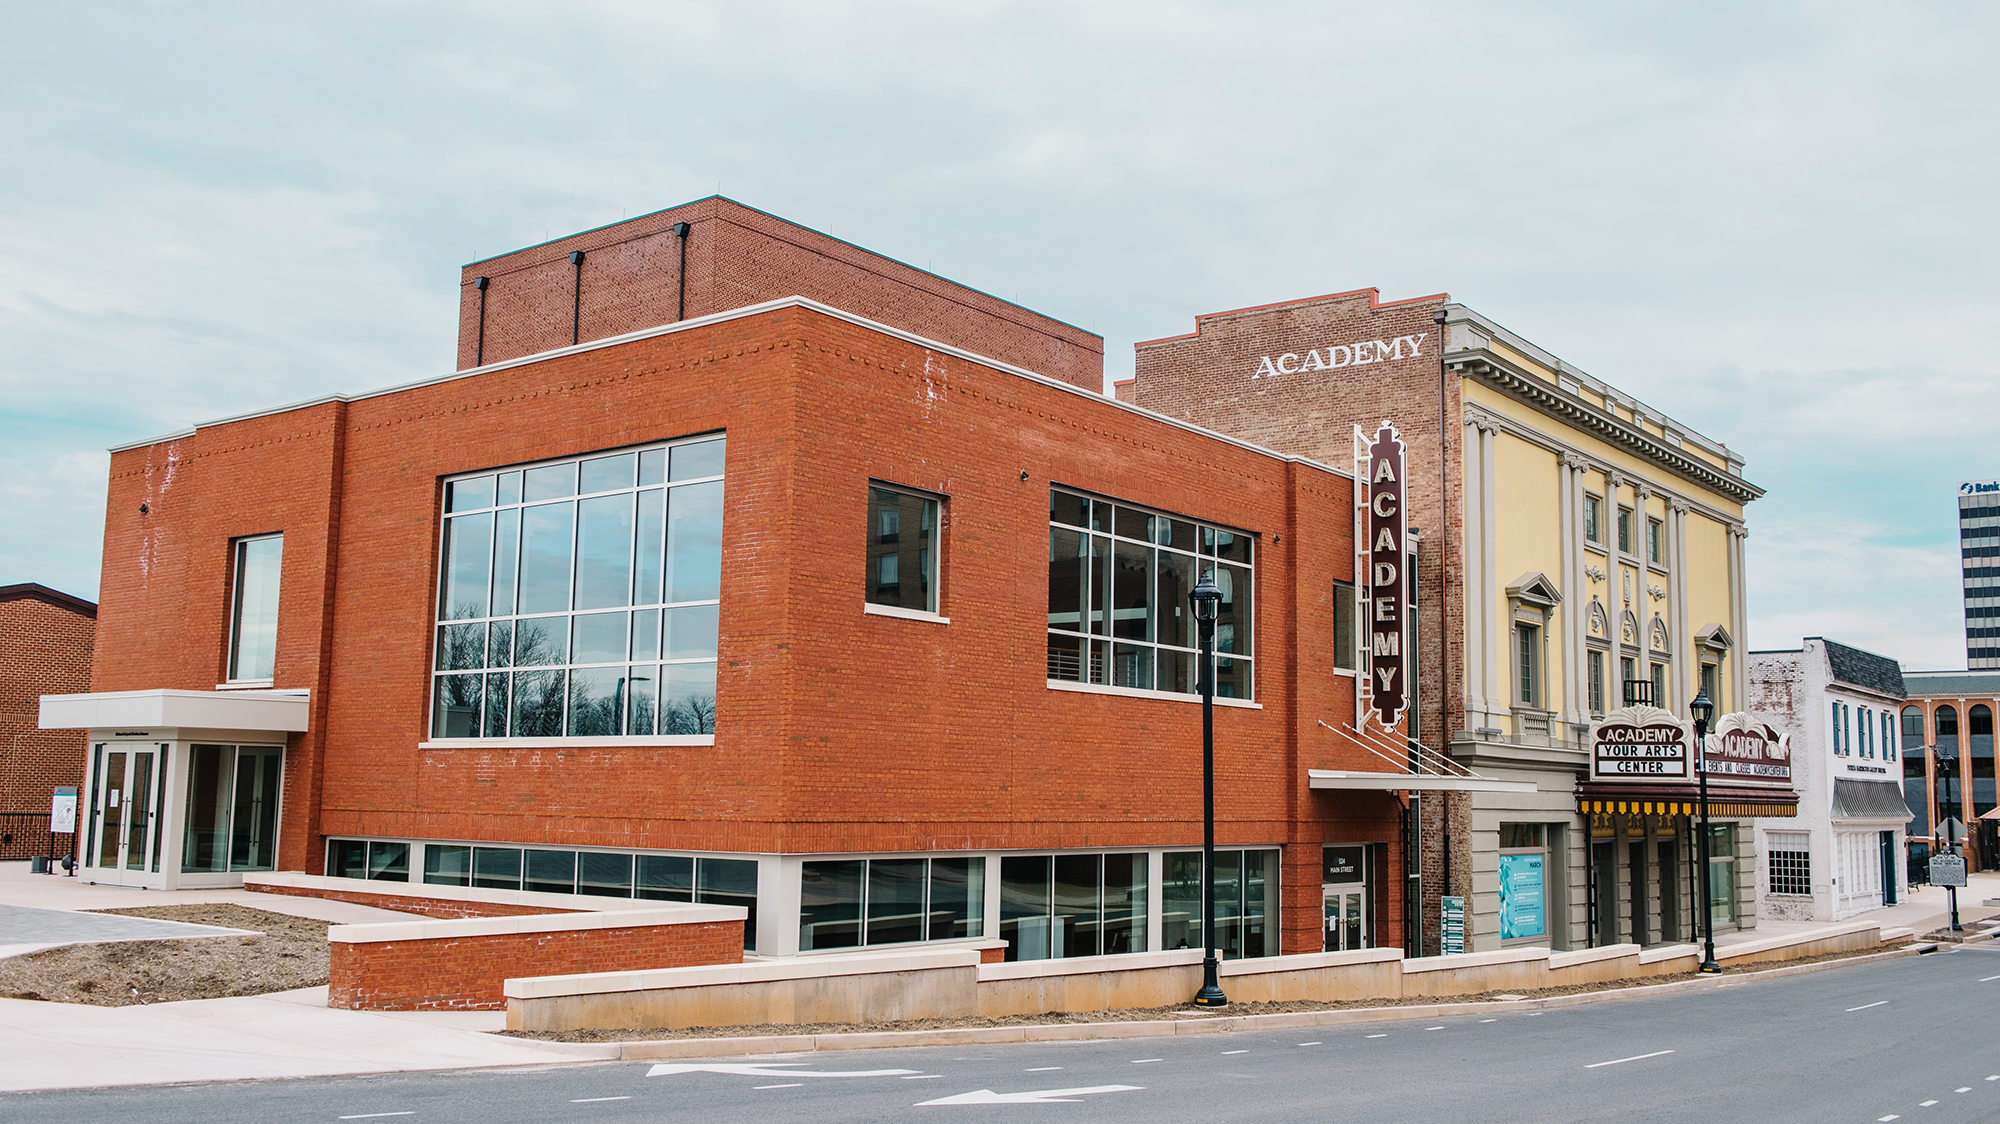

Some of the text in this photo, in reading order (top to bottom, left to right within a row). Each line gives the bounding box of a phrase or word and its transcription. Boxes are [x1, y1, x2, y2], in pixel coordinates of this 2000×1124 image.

[1251, 332, 1428, 380] ACADEMY
[1975, 481, 2000, 493] Bank
[1373, 458, 1399, 692] ACADEMY
[1605, 728, 1677, 742] ACADEMY
[1604, 745, 1677, 756] YOUR ARTS
[1724, 734, 1763, 760] ACADEMY
[1617, 761, 1664, 773] CENTER
[1708, 760, 1723, 772] EVENTS
[1736, 763, 1751, 774] CLASSES
[1338, 857, 1346, 865] 524
[1340, 865, 1354, 873] STREET
